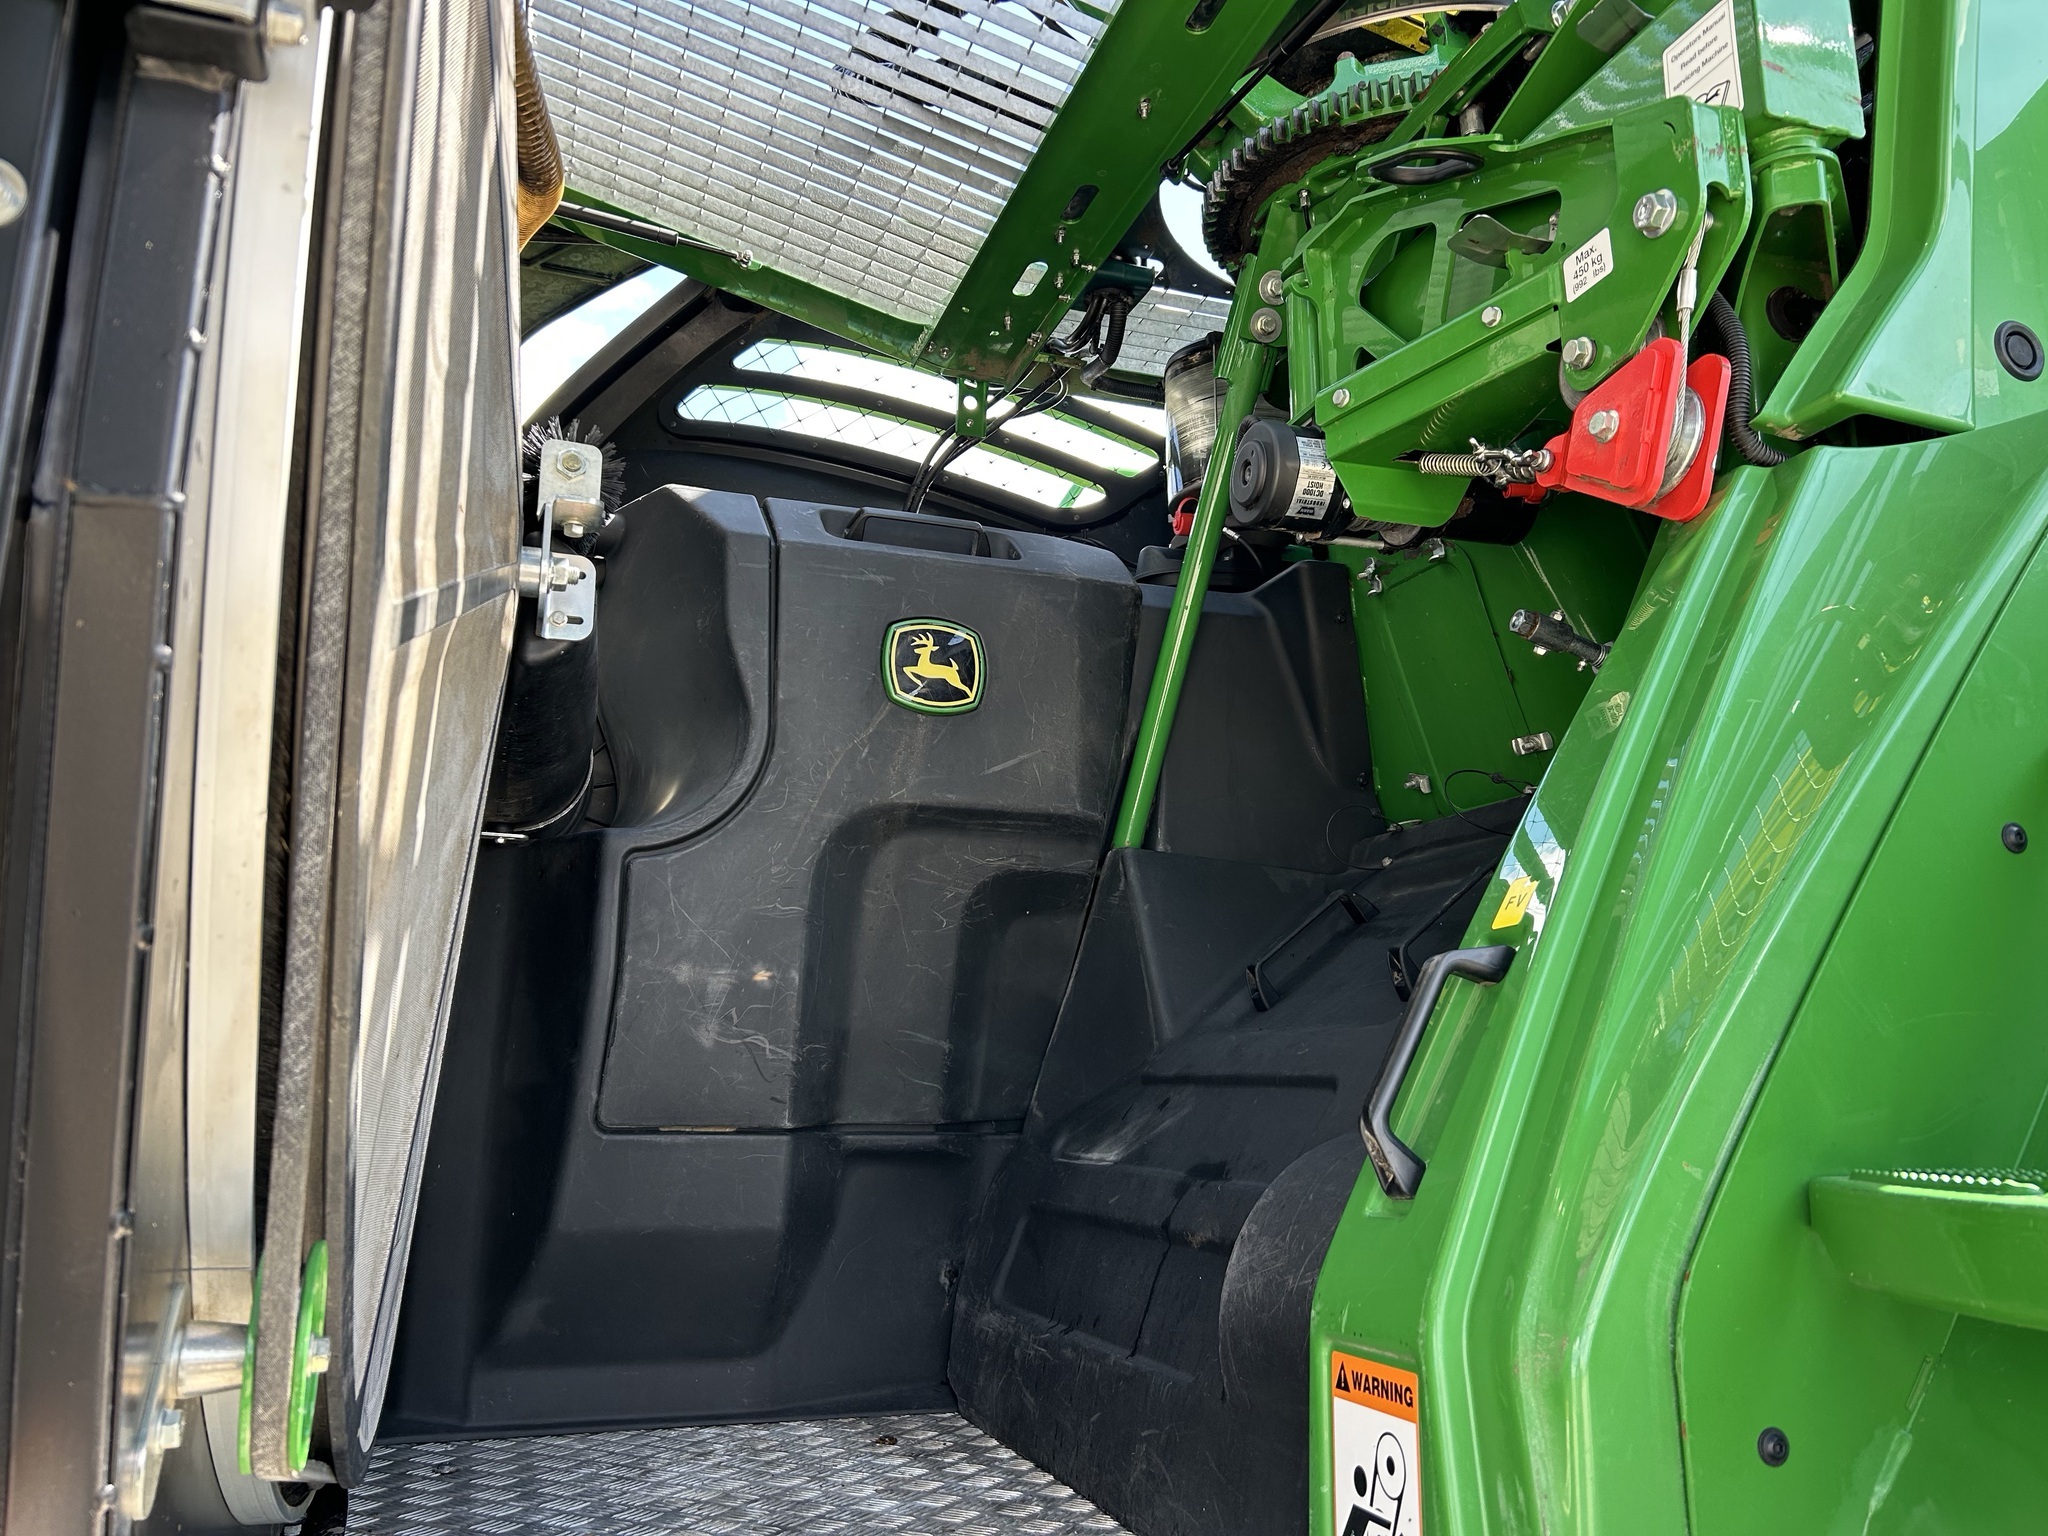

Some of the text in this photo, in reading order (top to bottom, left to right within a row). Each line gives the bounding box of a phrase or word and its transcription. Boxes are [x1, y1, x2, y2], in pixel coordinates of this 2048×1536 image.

[1670, 12, 1726, 63] Operators Manual
[1680, 35, 1718, 71] Read before
[1673, 42, 1729, 92] servicing Machine
[1573, 253, 1603, 280] 450 kg
[1575, 245, 1597, 266] Max.
[1572, 262, 1606, 295] (992 lbs)
[1302, 488, 1325, 497] DC1000
[1307, 481, 1324, 489] HOIST
[1296, 498, 1326, 507] INDUSTRIAL
[1505, 893, 1528, 911] FV
[1351, 1369, 1414, 1409] WARNING
